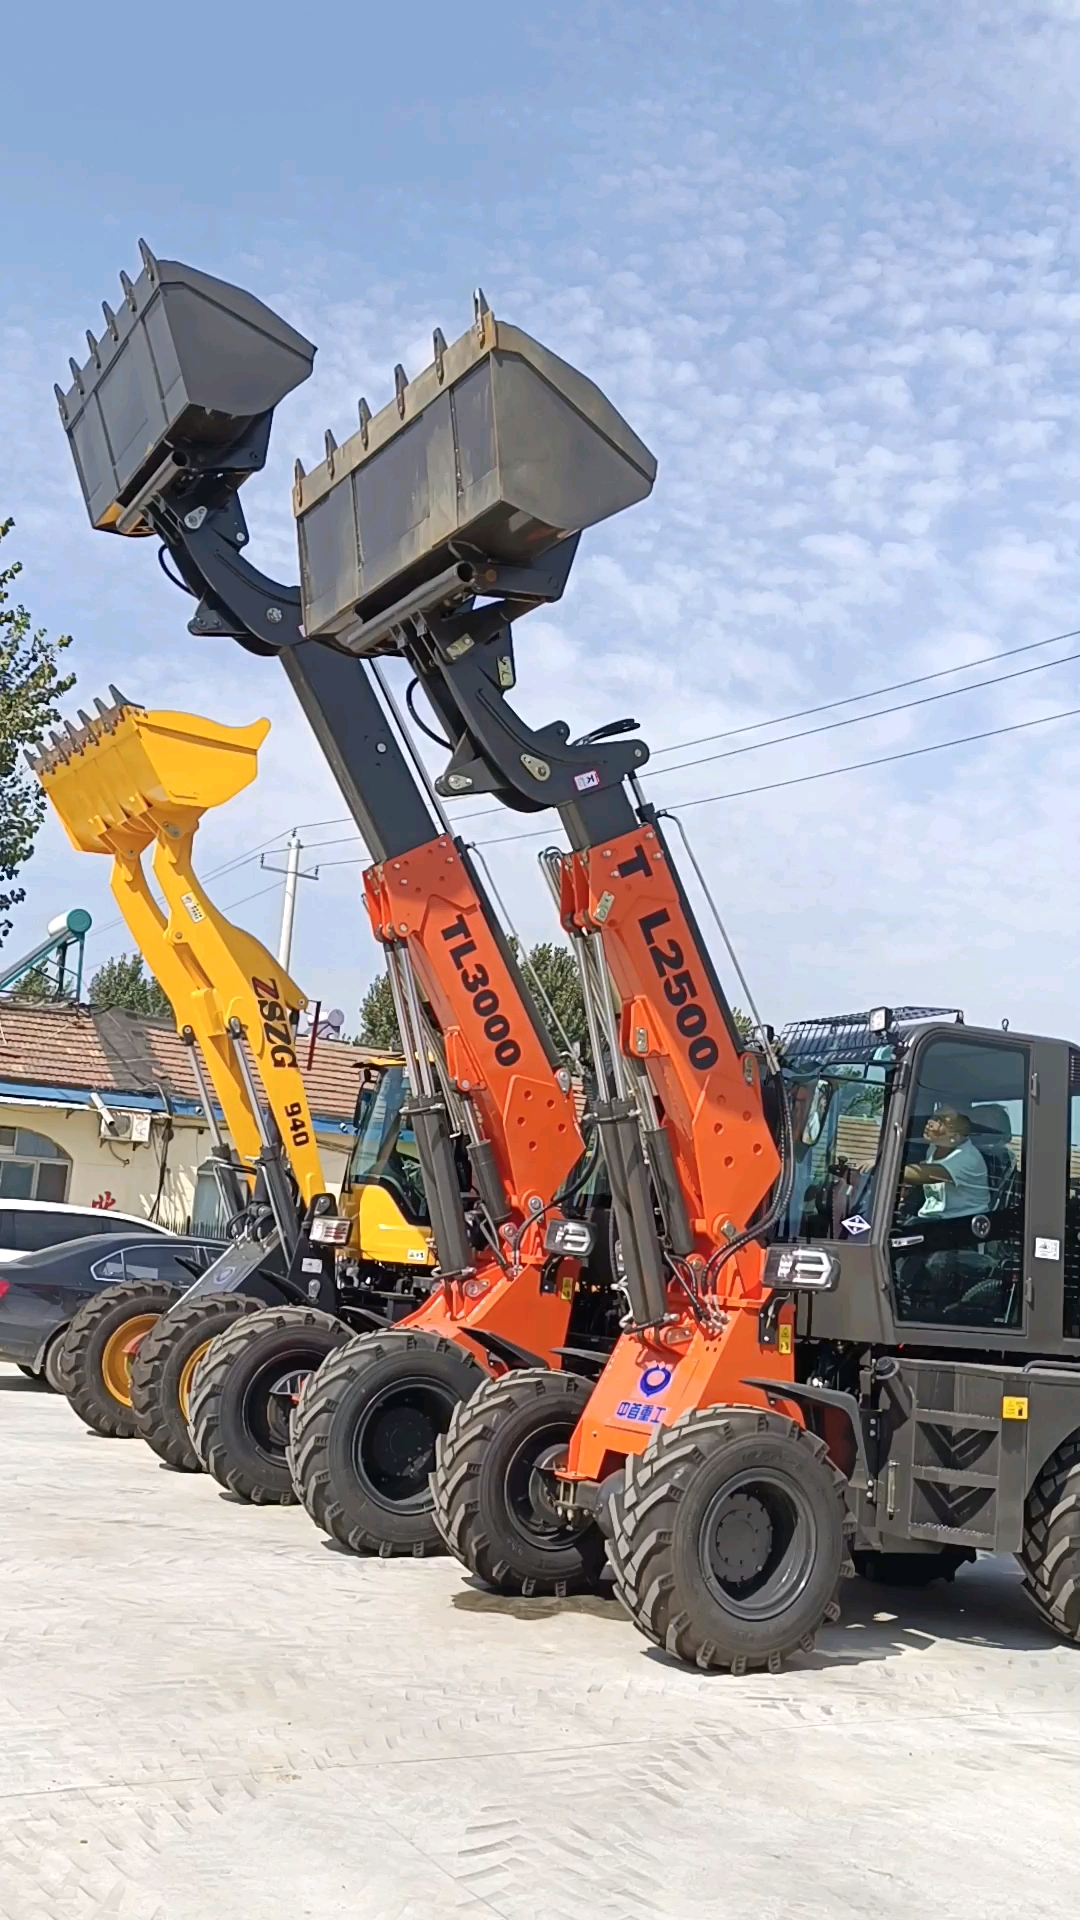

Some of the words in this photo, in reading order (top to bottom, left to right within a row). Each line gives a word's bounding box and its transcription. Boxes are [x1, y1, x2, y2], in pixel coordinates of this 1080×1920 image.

[252, 976, 298, 1068] ZSZG
[440, 914, 522, 1067] TL3000
[284, 1101, 309, 1147] 940
[616, 1401, 667, 1424] 中首重工
